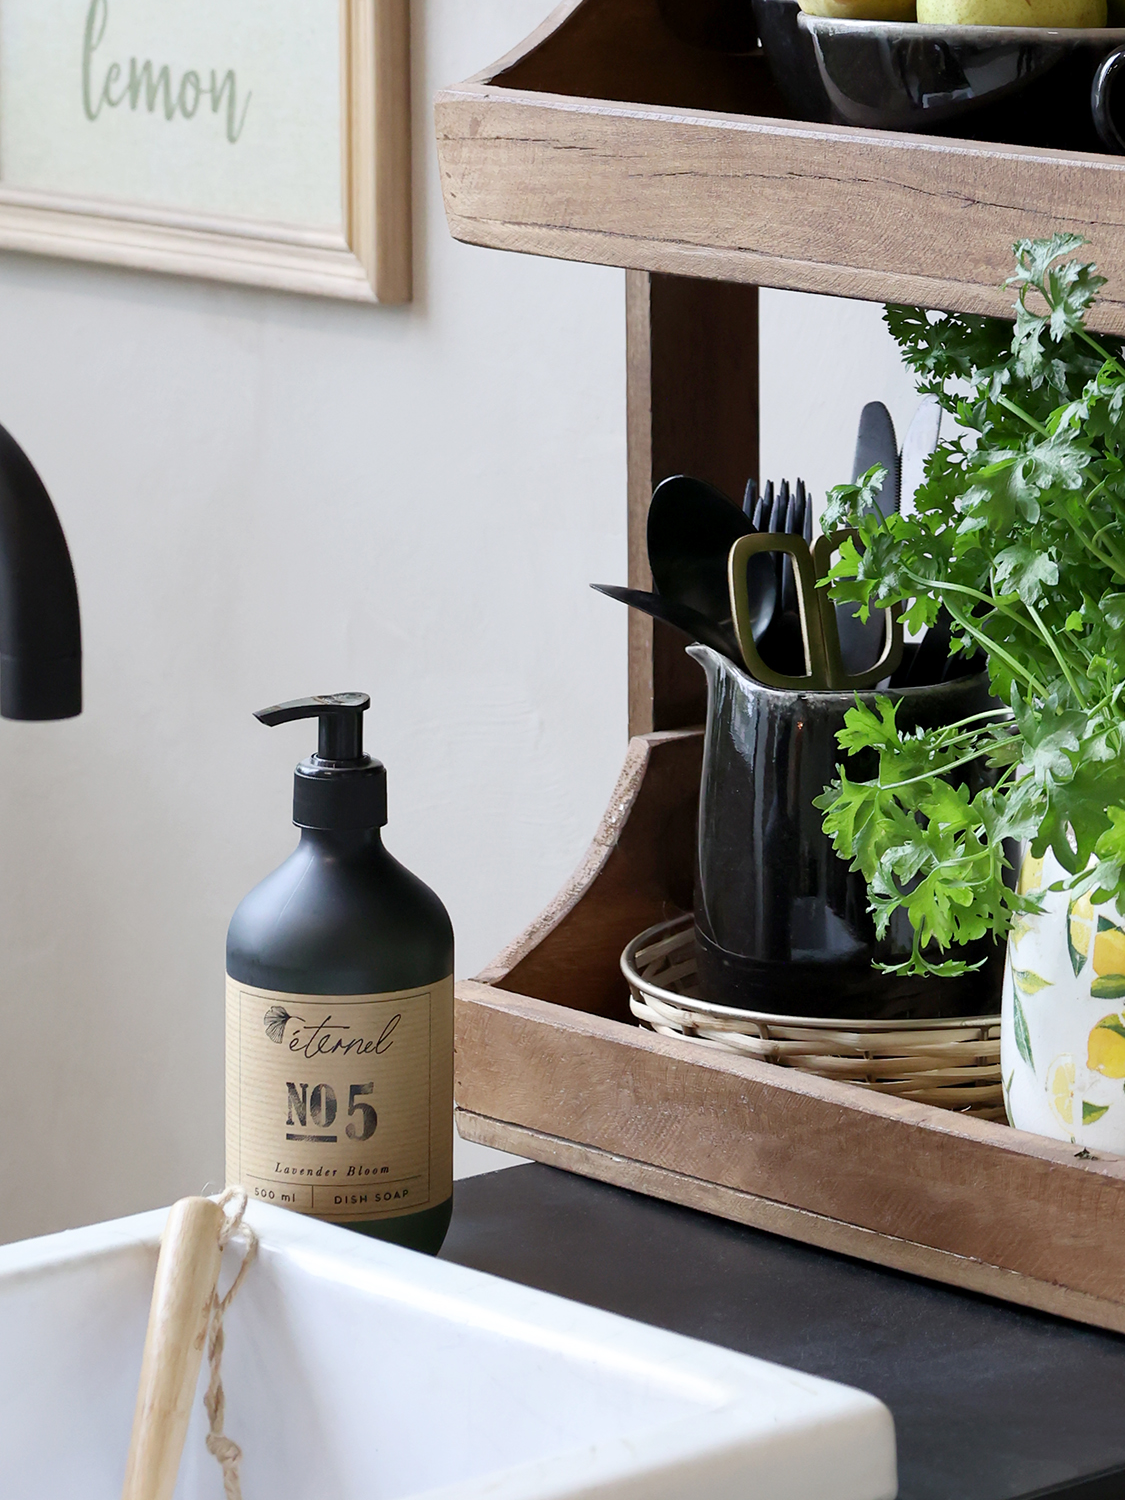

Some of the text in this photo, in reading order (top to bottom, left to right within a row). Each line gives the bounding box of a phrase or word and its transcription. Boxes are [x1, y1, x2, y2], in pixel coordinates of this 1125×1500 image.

[289, 1013, 402, 1059] éternel
[274, 1162, 390, 1177] Lavender Bloom
[254, 1187, 296, 1203] 500 ml
[334, 1189, 409, 1205] DISH SOAP
